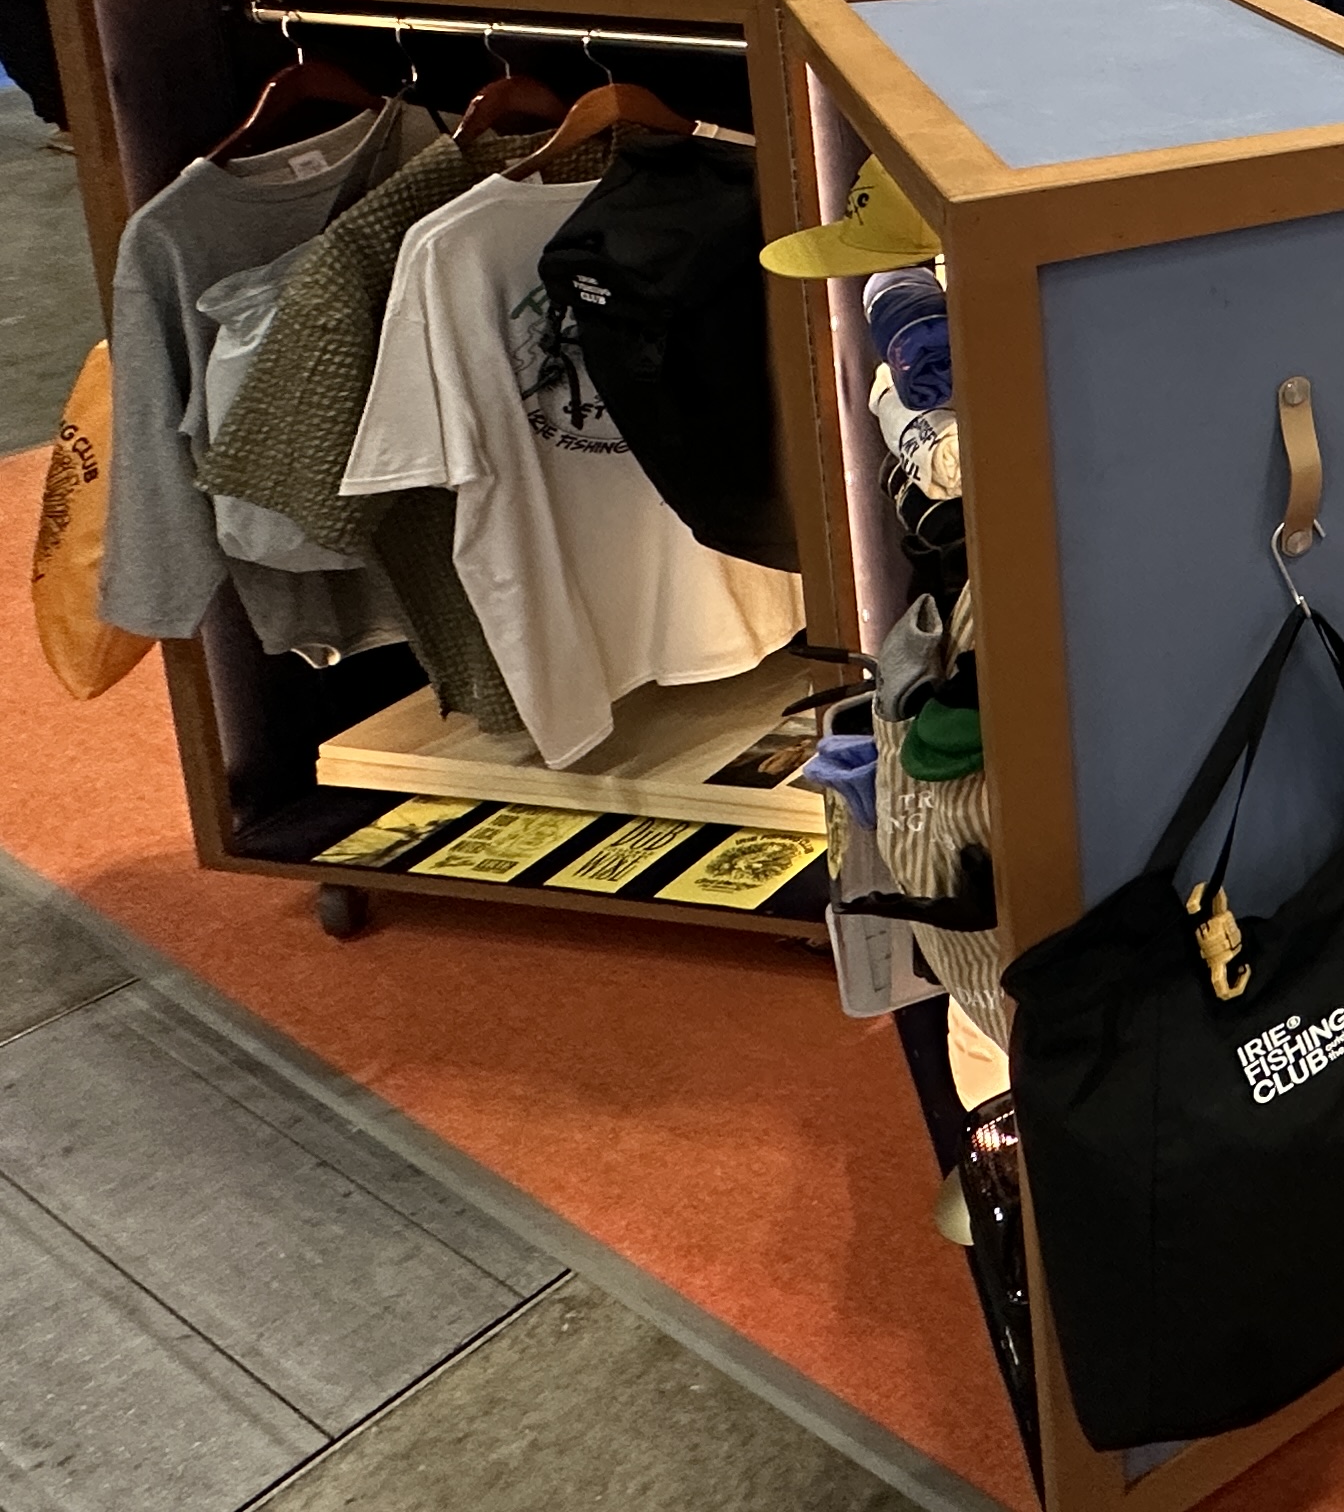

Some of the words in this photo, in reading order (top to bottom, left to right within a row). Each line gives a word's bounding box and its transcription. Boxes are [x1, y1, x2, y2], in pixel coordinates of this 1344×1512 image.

[580, 291, 606, 305] CLUB
[72, 437, 98, 483] CLUB
[1236, 1023, 1291, 1067] IRIE
[1328, 1045, 1344, 1061] the
[1253, 1048, 1329, 1104] CLUB
